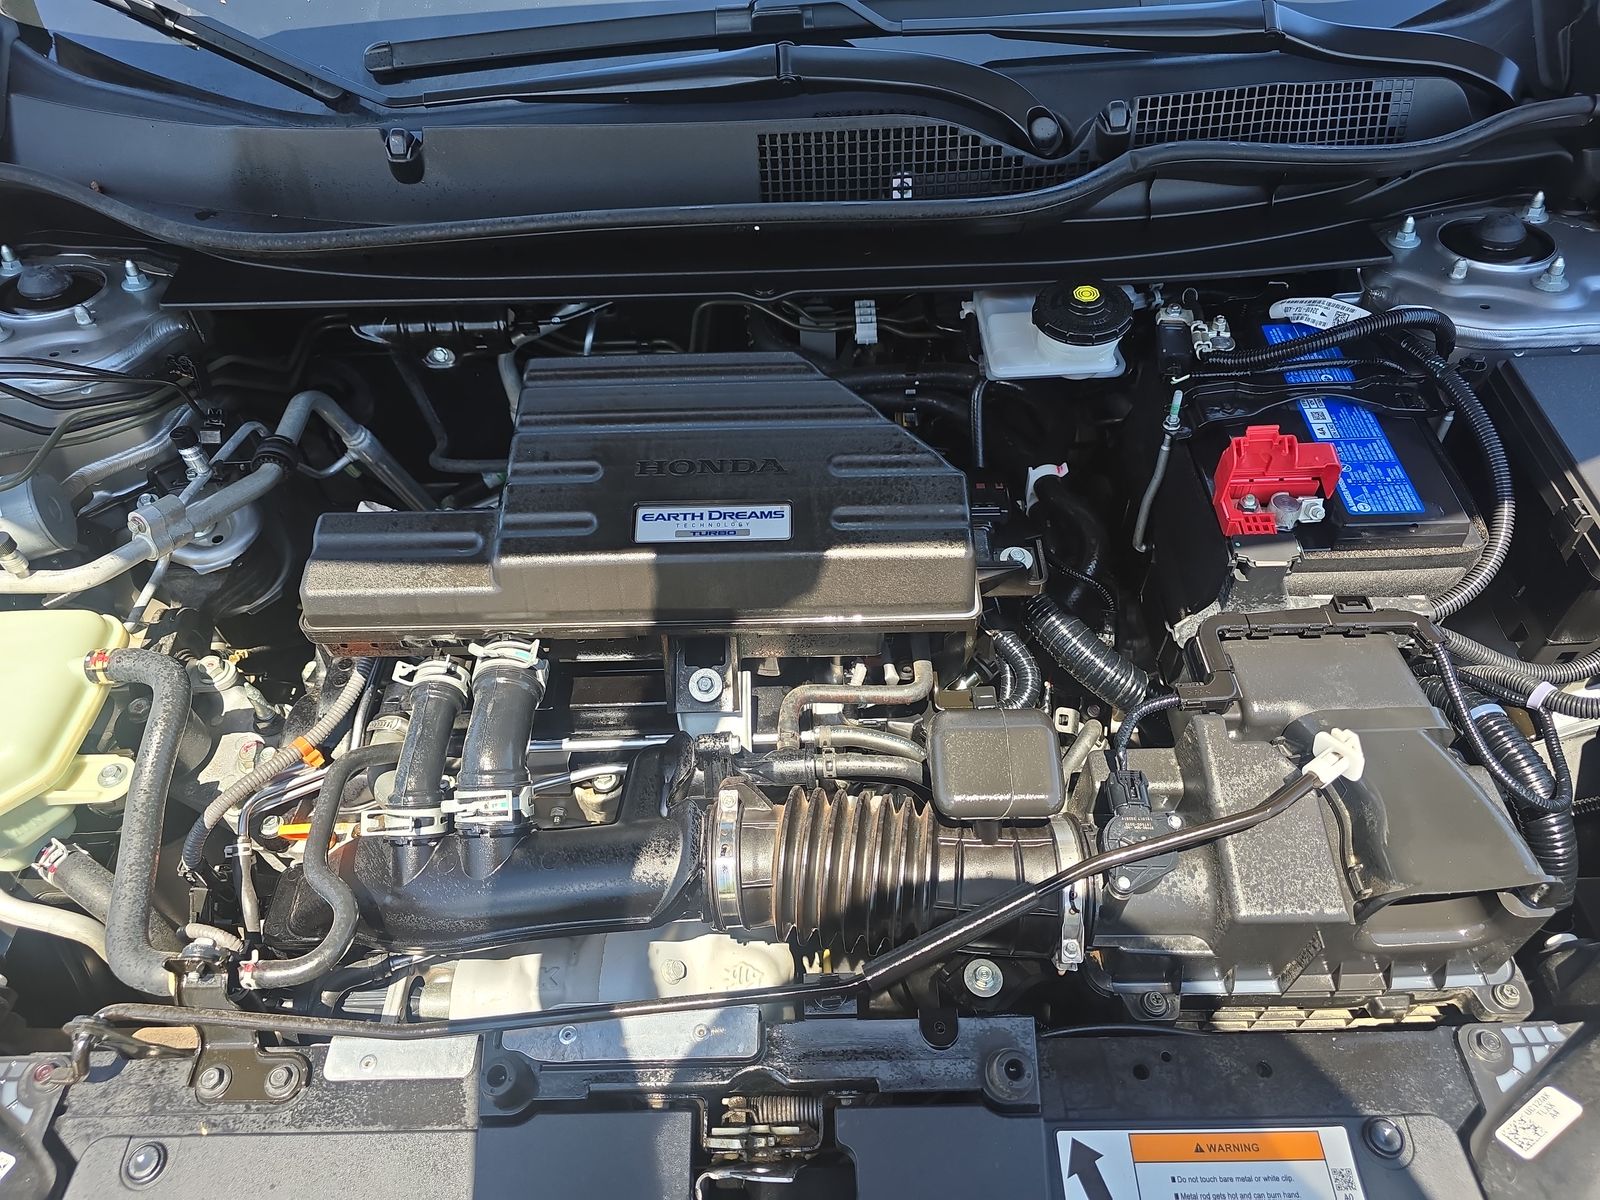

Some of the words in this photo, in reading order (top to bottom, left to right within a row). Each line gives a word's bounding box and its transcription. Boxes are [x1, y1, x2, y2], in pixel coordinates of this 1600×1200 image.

[634, 458, 789, 477] HONDA
[641, 512, 704, 522] EARTH
[708, 510, 785, 521] DREAMS
[1206, 1143, 1260, 1152] WARNING
[1176, 1175, 1187, 1183] Do
[1188, 1175, 1199, 1183] not
[1200, 1175, 1217, 1183] touch
[1219, 1175, 1234, 1183] bare
[1235, 1175, 1253, 1183] metal
[1262, 1174, 1280, 1182] white
[1281, 1174, 1295, 1183] clip.
[1180, 1192, 1199, 1200] Metal
[1200, 1192, 1211, 1200] rod
[1227, 1192, 1238, 1200] hot
[1239, 1191, 1251, 1200] and
[1266, 1191, 1281, 1199] burn
